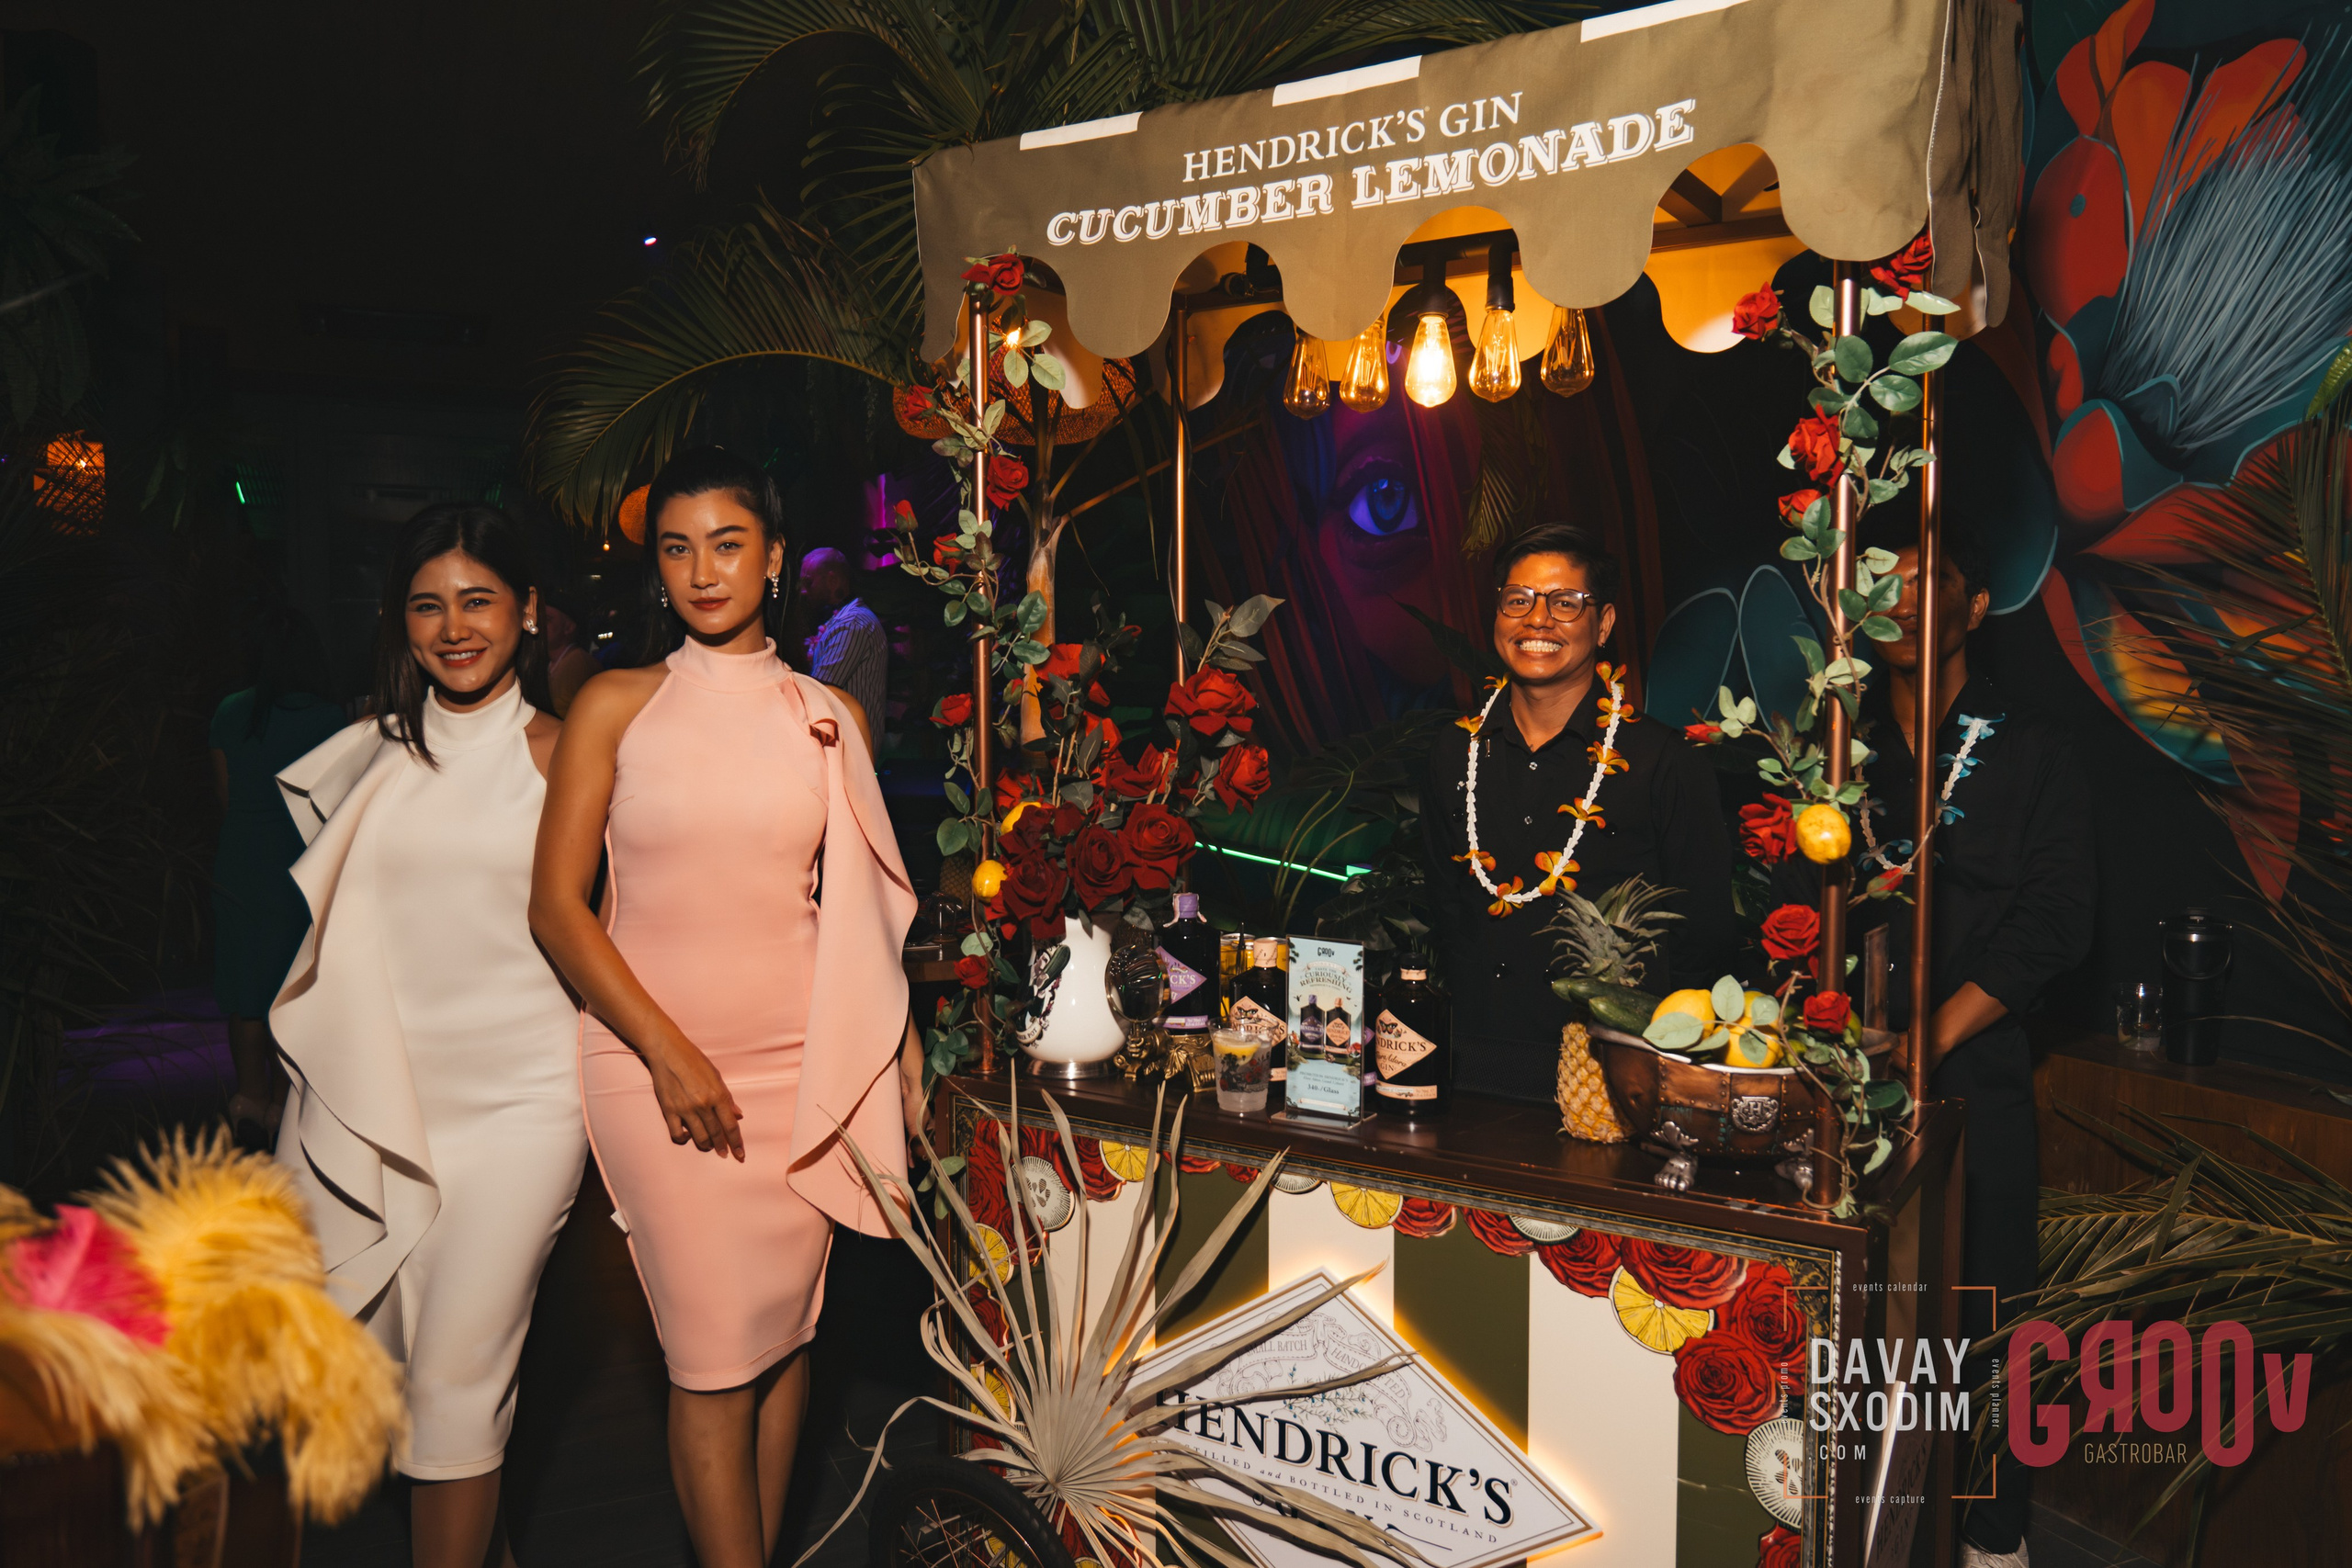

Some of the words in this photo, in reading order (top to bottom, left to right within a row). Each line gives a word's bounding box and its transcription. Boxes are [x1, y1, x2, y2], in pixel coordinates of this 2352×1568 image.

[1183, 108, 1426, 183] HENDRICK'S
[1440, 91, 1523, 137] GIN
[1046, 174, 1335, 245] CUCUMBER
[1351, 98, 1696, 209] LEMONADE
[1299, 976, 1352, 993] REFRESHING
[1305, 970, 1347, 983] CURIOUSLY
[1375, 1037, 1427, 1052] NDRICK'S
[1380, 1062, 1395, 1072] GIN
[1277, 1339, 1307, 1352] BATCH
[1259, 1468, 1282, 1480] and
[1289, 1474, 1365, 1505] BOTTLED
[1374, 1500, 1393, 1513] IN
[1403, 1508, 1498, 1543] SCOTLAND
